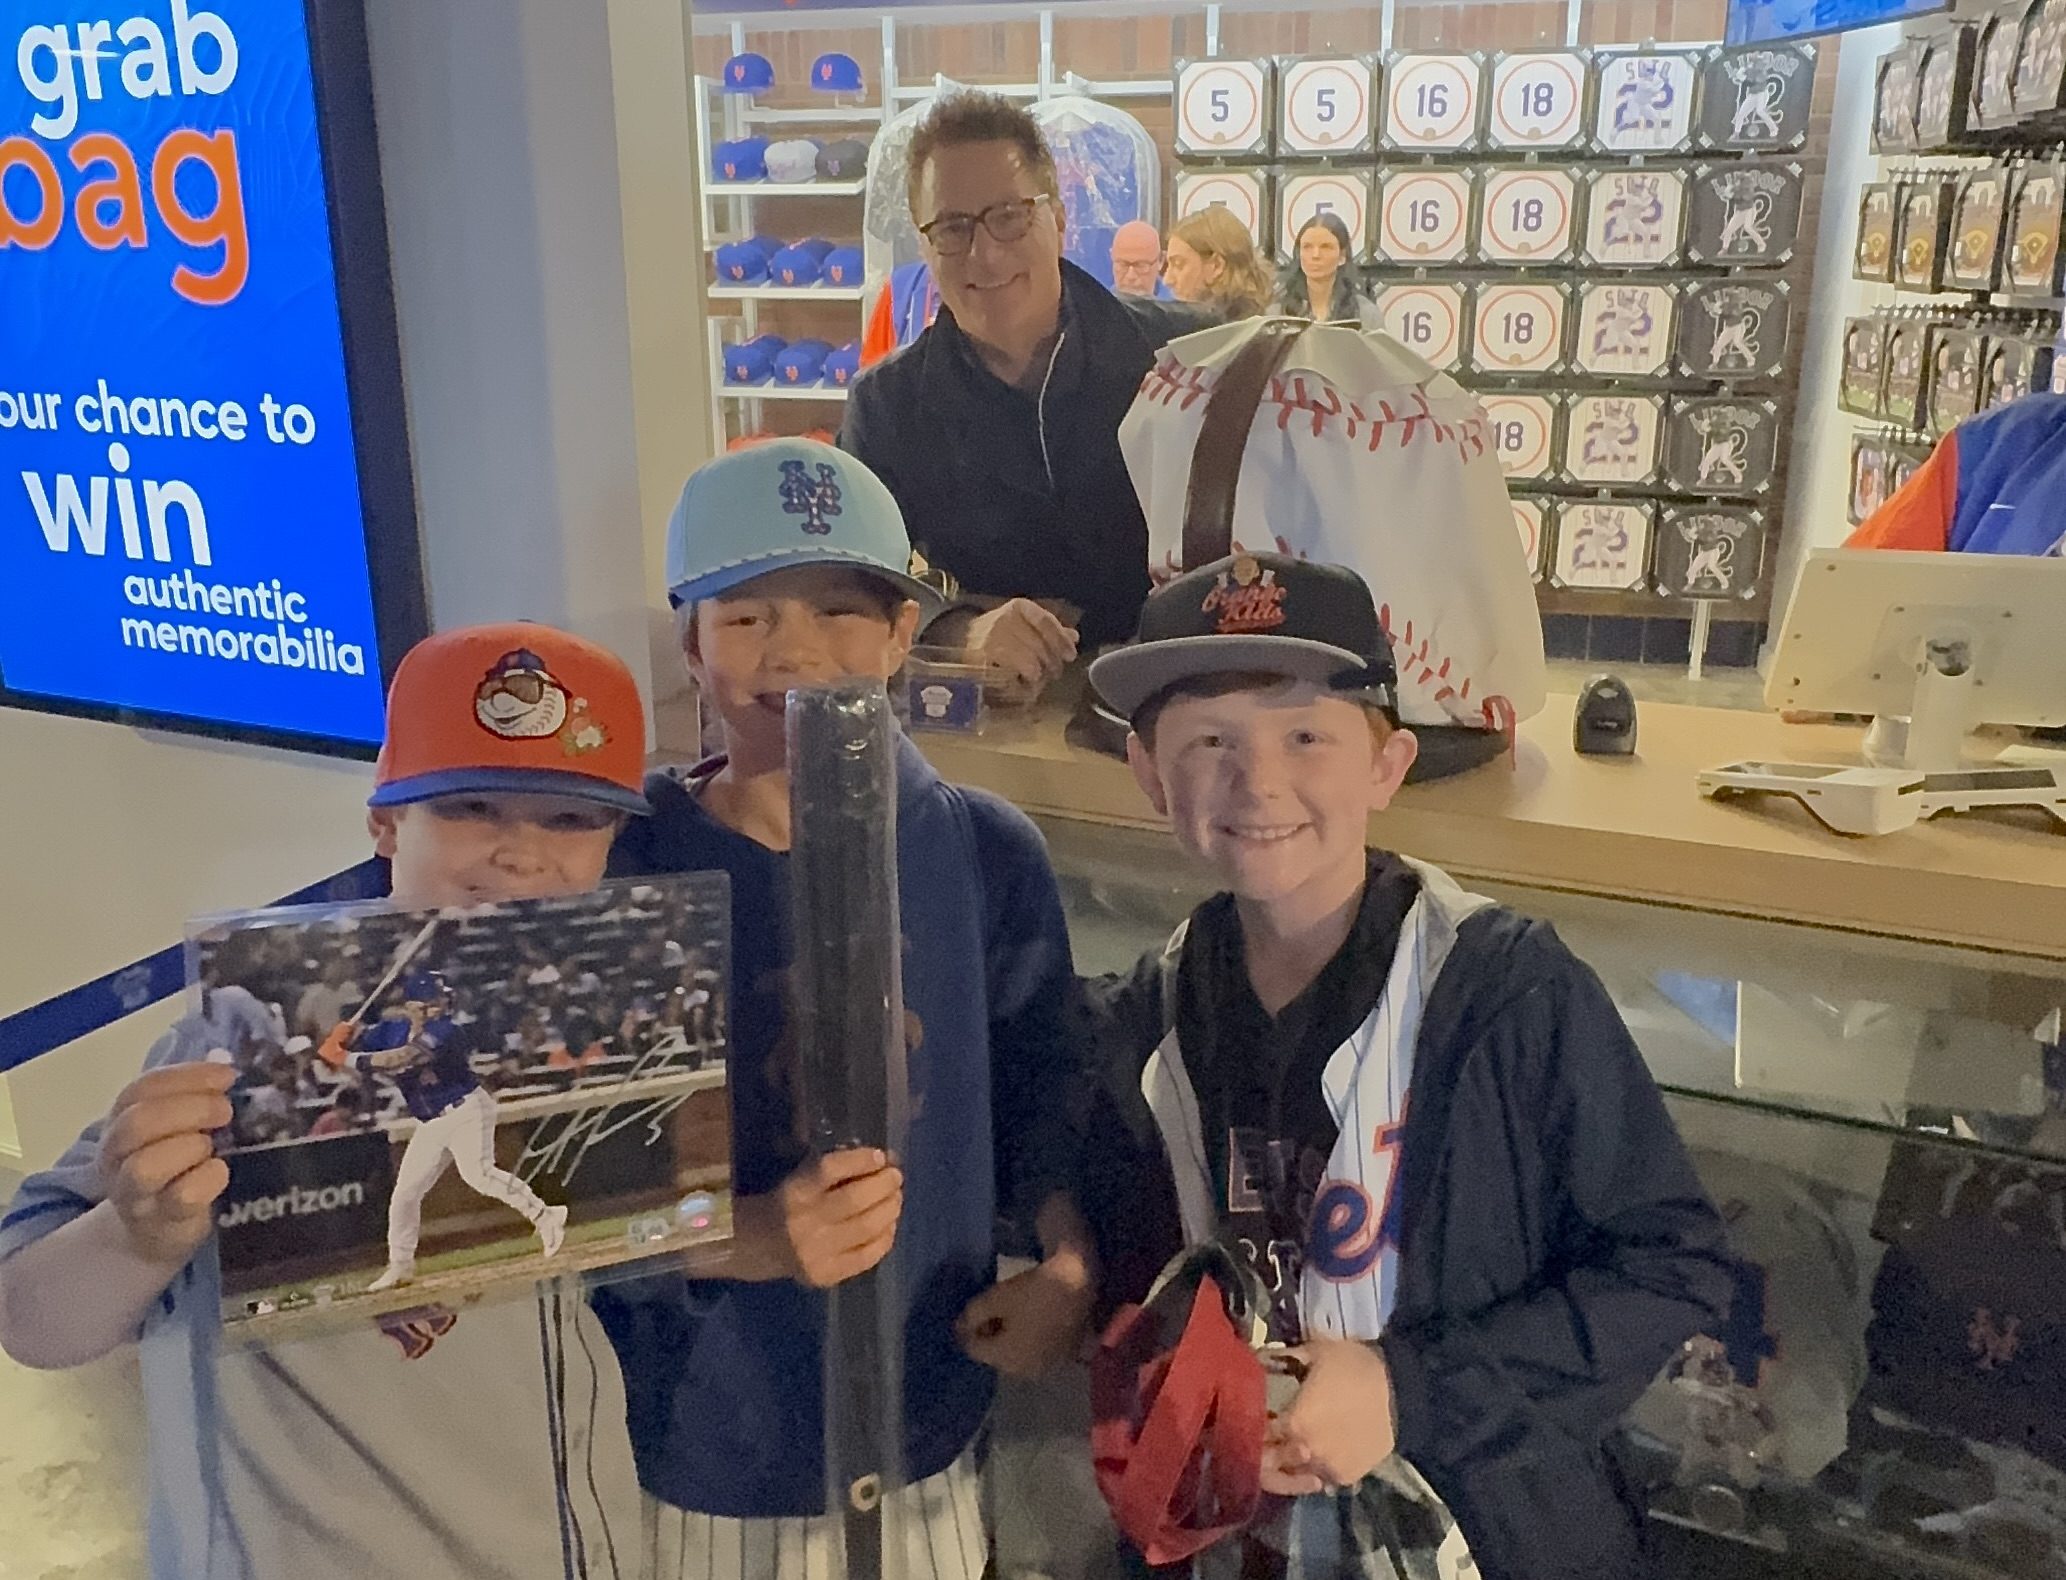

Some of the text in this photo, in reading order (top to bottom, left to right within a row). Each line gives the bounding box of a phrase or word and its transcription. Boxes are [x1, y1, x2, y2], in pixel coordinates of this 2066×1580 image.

[18, 0, 238, 139] grab
[1211, 89, 1230, 122] 5
[1316, 88, 1336, 122] 5
[1417, 83, 1449, 118] 16
[1521, 82, 1554, 117] 18
[1409, 199, 1440, 232] 16
[1511, 198, 1544, 232] 18
[1401, 311, 1432, 343] 16
[1503, 311, 1534, 344] 18
[75, 378, 247, 440] chance
[260, 393, 316, 445] to
[1495, 421, 1524, 451] 18
[21, 442, 212, 566] win
[124, 569, 308, 623] authentic
[121, 617, 365, 676] memorabilia
